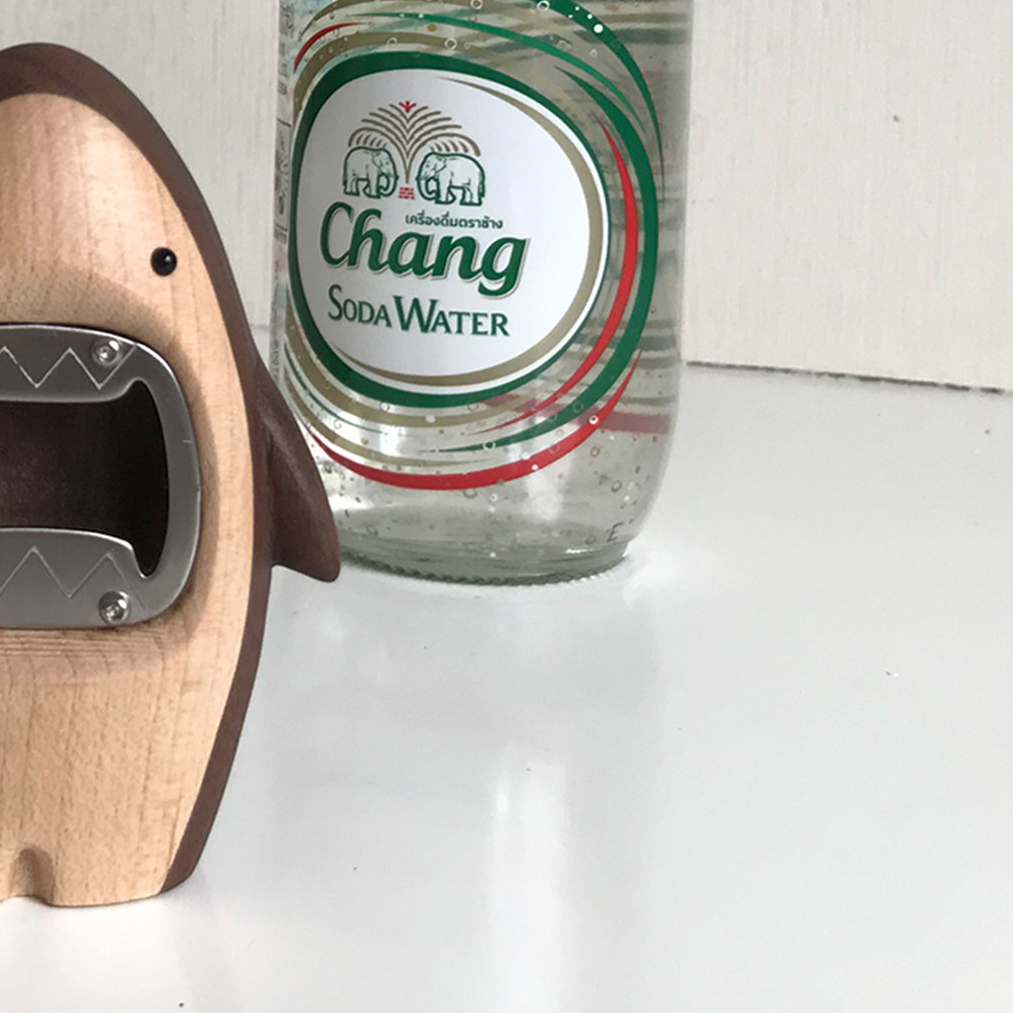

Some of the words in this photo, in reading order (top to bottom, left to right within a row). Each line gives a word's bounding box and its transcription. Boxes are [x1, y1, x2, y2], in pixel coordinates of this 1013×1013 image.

[405, 209, 504, 229] เครื่องดื่มตราช้าง
[320, 201, 531, 299] Chang
[328, 284, 391, 327] SODA
[393, 296, 511, 337] WATER
